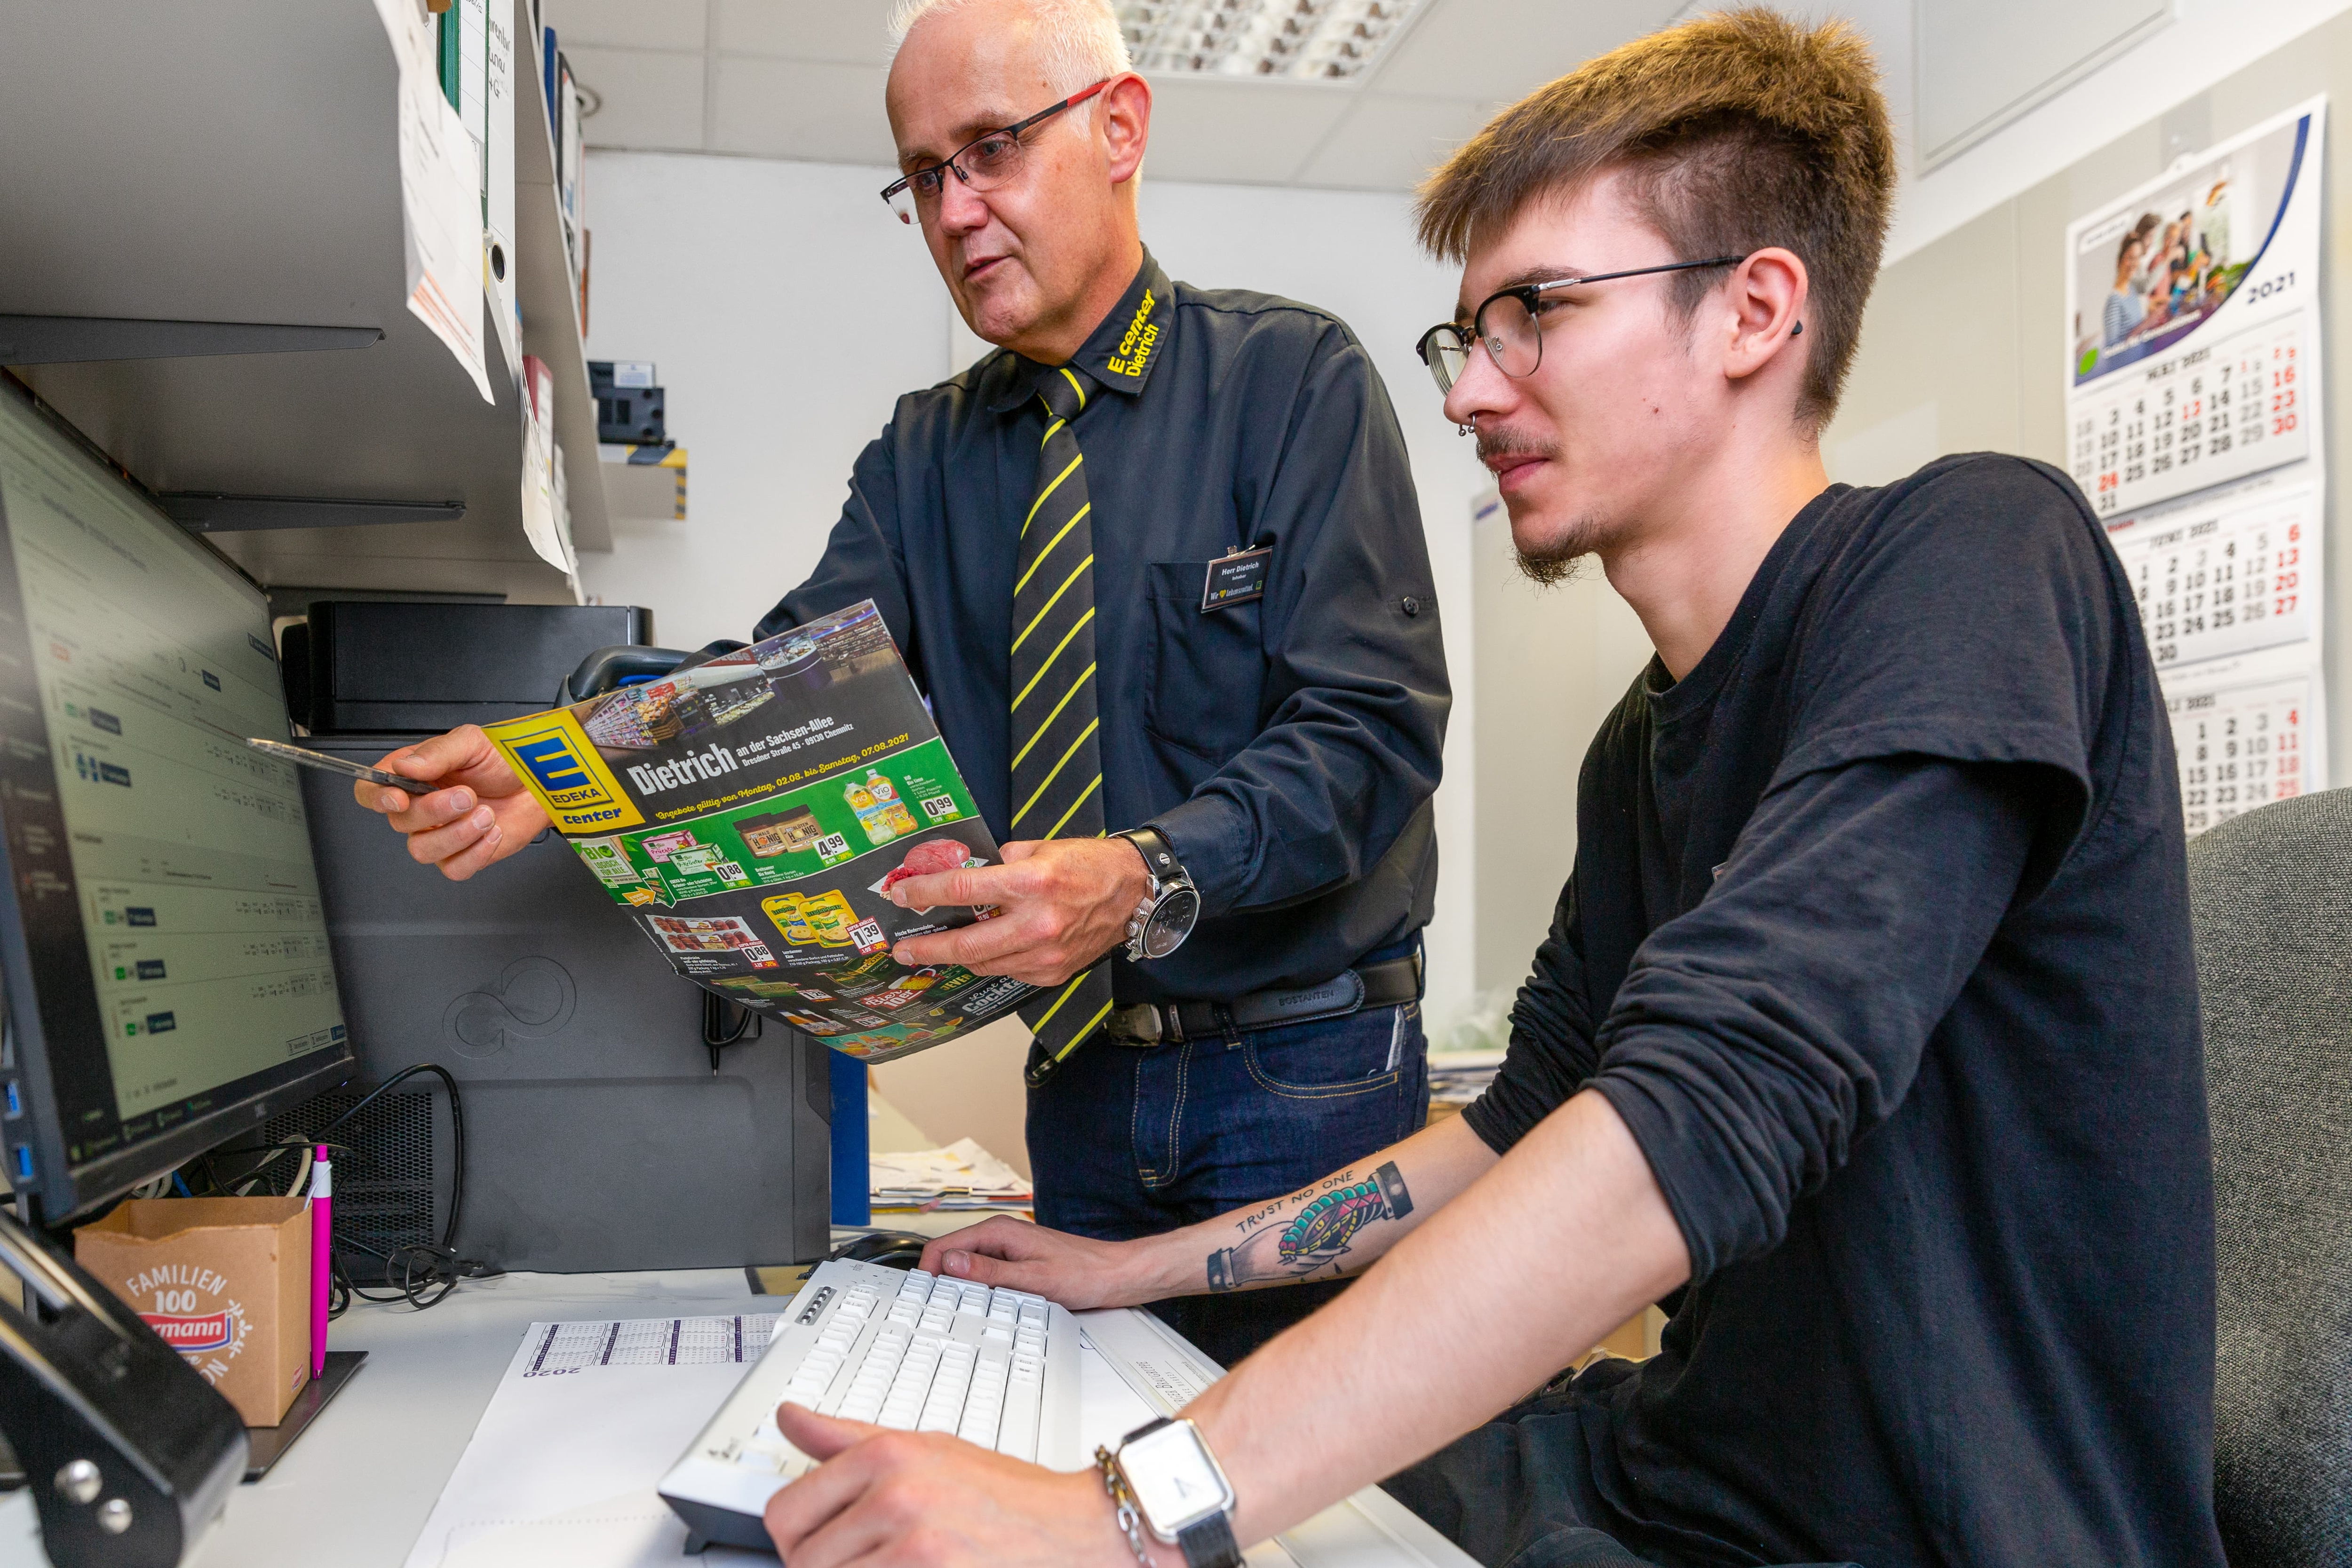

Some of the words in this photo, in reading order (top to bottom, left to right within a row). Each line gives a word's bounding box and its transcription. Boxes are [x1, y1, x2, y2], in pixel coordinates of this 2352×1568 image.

[2246, 271, 2296, 305] 2021
[1107, 356, 1126, 374] E
[1119, 288, 1155, 356] center
[1125, 324, 1159, 377] Dietrich
[2181, 399, 2201, 422] 13
[2273, 364, 2296, 389] 16
[2272, 389, 2296, 412] 23
[2098, 470, 2119, 493] 24
[2272, 412, 2297, 436] 30
[2288, 523, 2301, 542] 6
[1236, 562, 1259, 572] Dietrich
[2278, 548, 2299, 568] 13
[2275, 572, 2298, 592] 20
[2275, 595, 2297, 616] 27
[2288, 709, 2298, 725] 4
[742, 754, 770, 767] Dresdner
[770, 746, 792, 758] Straße
[792, 742, 801, 751] 45
[804, 734, 825, 746] 09130
[824, 723, 854, 739] Chemnitz
[513, 737, 591, 792] E
[626, 743, 739, 795] Dietrich
[736, 746, 749, 757] an
[749, 740, 766, 752] der
[765, 716, 834, 746] Sachsen-Allee
[656, 805, 696, 820] Angebote
[696, 799, 721, 812] gültig
[721, 795, 738, 804] von
[737, 783, 776, 798] Montag,
[776, 772, 803, 786] 02.08.
[804, 768, 818, 777] bis
[818, 754, 860, 774] Samstag,
[861, 732, 909, 757] 07.08.2021
[551, 788, 602, 803] EDEKA
[563, 808, 622, 824] center
[793, 821, 809, 831] BLÜTEN
[805, 904, 844, 917] LEERDAMMER
[847, 918, 874, 931] SUPER-KNÜLLER
[859, 952, 885, 972] JACOBS
[940, 974, 973, 991] JEVER
[866, 990, 902, 1006] Bier
[883, 990, 914, 1007] 10er
[962, 980, 1025, 1012] Cockta
[1236, 1200, 1284, 1234] TRUST
[1292, 1188, 1314, 1204] NO
[1322, 1170, 1354, 1189] ONE
[126, 1264, 228, 1297] FAMILIEN
[155, 1290, 196, 1313] 100
[151, 1321, 222, 1338] rmann
[523, 1367, 580, 1378] 2020
